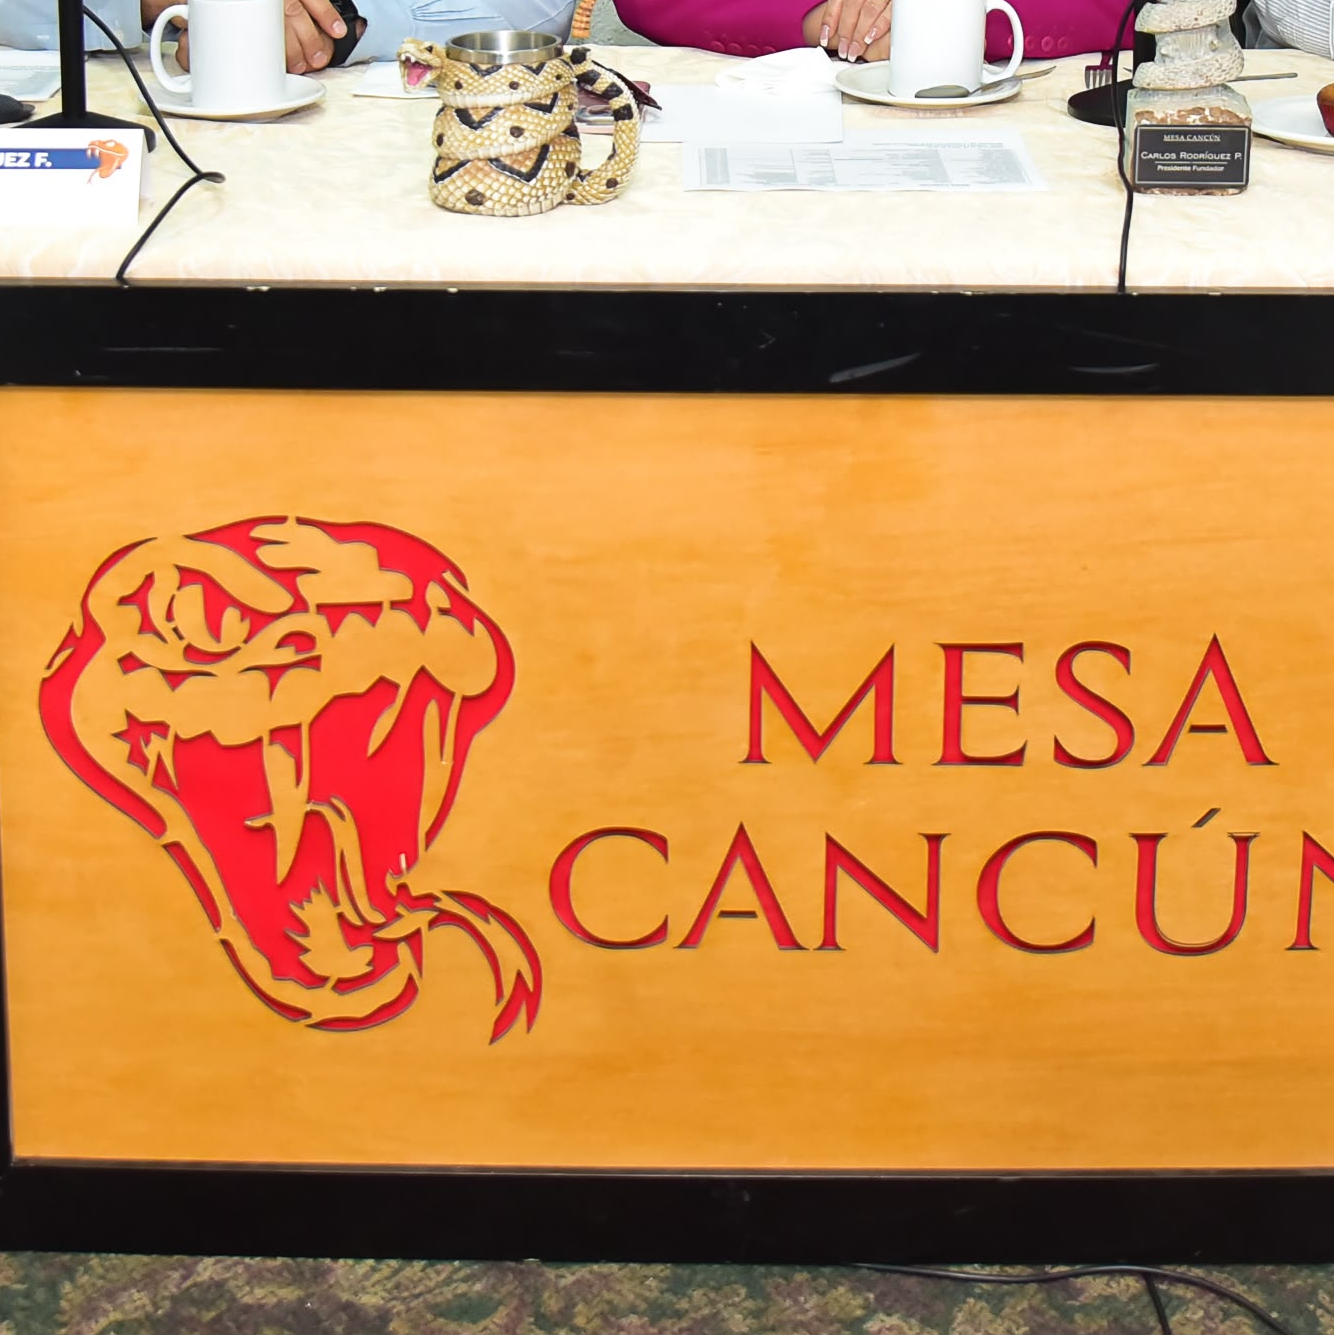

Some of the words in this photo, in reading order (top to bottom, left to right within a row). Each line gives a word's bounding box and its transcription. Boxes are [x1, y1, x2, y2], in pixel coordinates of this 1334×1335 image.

[1163, 134, 1185, 142] MESA
[34, 151, 53, 168] F.
[1140, 151, 1177, 160] CARLOS
[738, 633, 1280, 770] MESA
